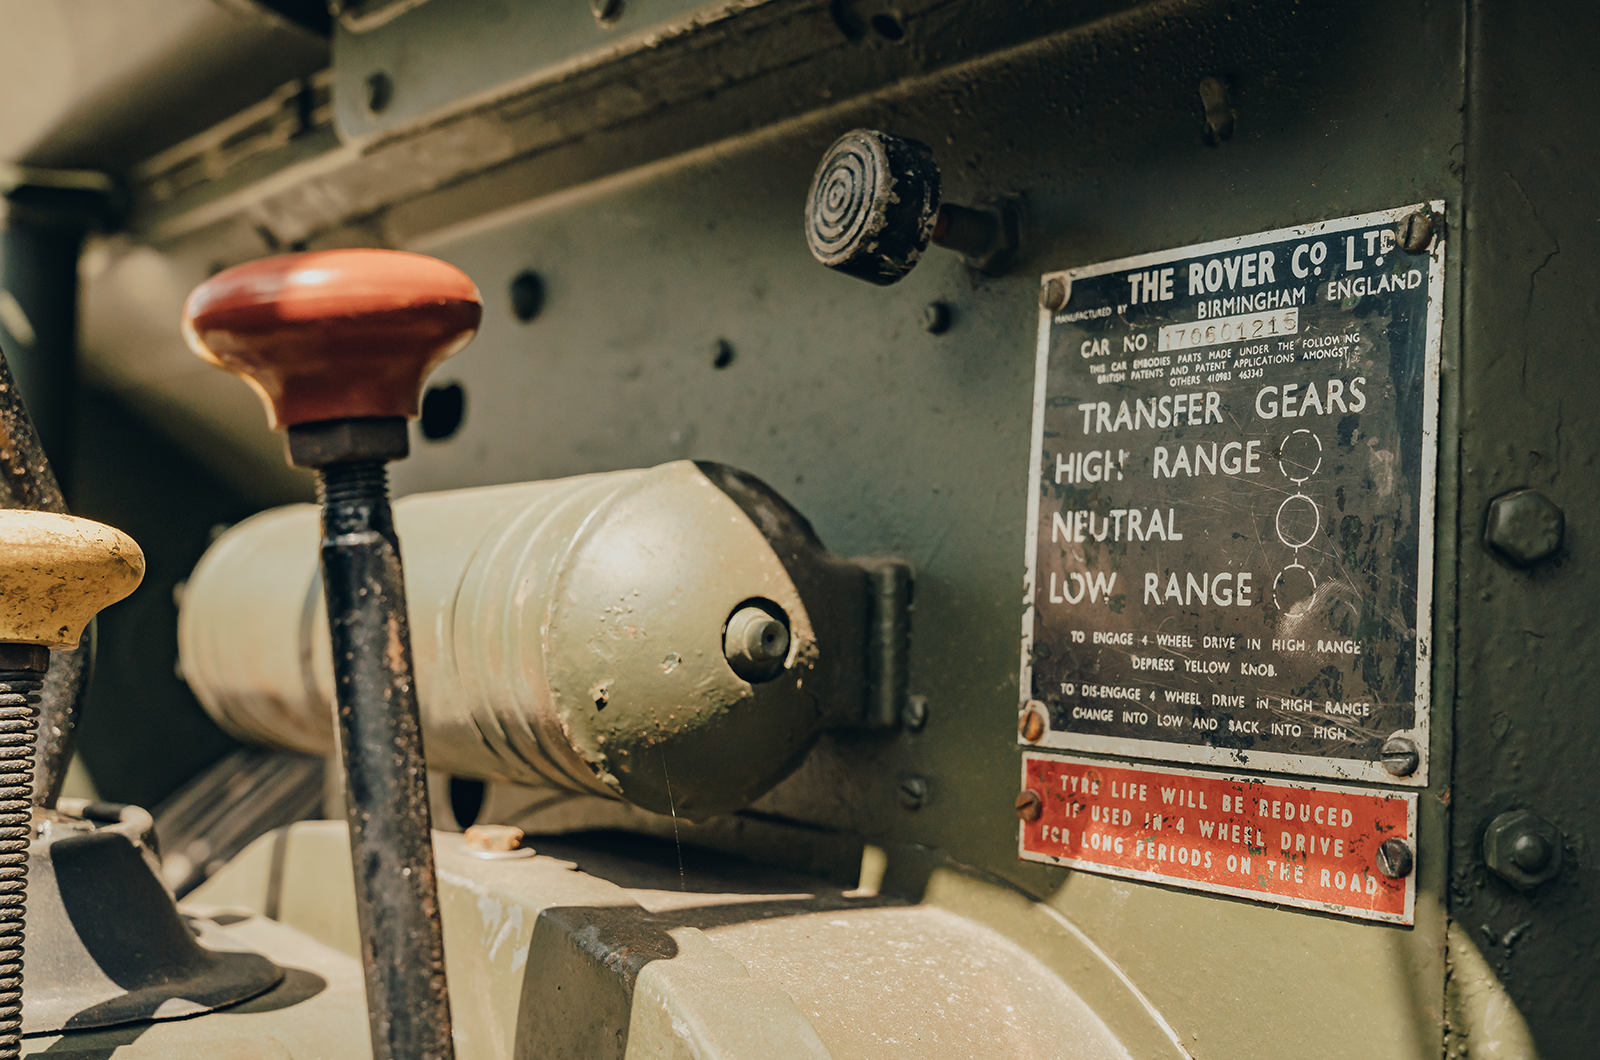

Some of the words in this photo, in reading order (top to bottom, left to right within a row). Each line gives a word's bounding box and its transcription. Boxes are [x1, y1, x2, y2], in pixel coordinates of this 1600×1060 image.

[1128, 268, 1174, 305] THE
[1189, 251, 1275, 296] ROVER
[1198, 286, 1306, 319] BIRMINGHAM
[1328, 269, 1422, 300] ENGLAND
[1117, 304, 1127, 314] BY
[1081, 338, 1110, 358] CAR
[1124, 334, 1148, 353] NO
[1090, 364, 1106, 374] THIS
[1111, 361, 1127, 371] CAR
[1133, 357, 1171, 369] EMBODIES
[1178, 353, 1201, 363] PARTS
[1209, 349, 1232, 359] MADE
[1240, 344, 1269, 356] UNDER
[1278, 341, 1294, 350] THE
[1097, 373, 1125, 384] BRITISH
[1131, 368, 1164, 379] PATENTS
[1170, 366, 1189, 376] AND
[1195, 361, 1226, 372] PATENT
[1233, 353, 1295, 368] APPLICATIONS
[1302, 346, 1349, 360] AMONGST
[1169, 375, 1201, 387] OTHERS
[1078, 391, 1223, 435] TRANSFER
[1255, 377, 1366, 419] GEARS
[1055, 449, 1124, 484] HIGH
[1153, 440, 1261, 479] RANGE
[1051, 508, 1183, 543] NEUTRAL
[1050, 571, 1117, 604] LOW
[1144, 572, 1252, 606] RANGE
[1071, 630, 1085, 643] TO
[1093, 631, 1134, 645] ENGAGE
[1141, 635, 1148, 645] 4
[1157, 634, 1193, 648] WHEEL
[1203, 636, 1236, 650] DRIVE
[1247, 638, 1261, 650] IN
[1272, 639, 1305, 651] HIGH
[1317, 640, 1361, 654] RANGE
[1132, 657, 1174, 671] DEPRESS
[1184, 660, 1231, 674] YELLOW
[1240, 662, 1278, 677] KNOB.
[1060, 682, 1075, 696] TO
[1149, 691, 1156, 701] 4
[1164, 690, 1202, 705] WHEEL
[1212, 694, 1245, 709] DRIVE
[1256, 697, 1269, 709] IN
[1280, 698, 1313, 712] HIGH
[1325, 701, 1370, 717] RANGE
[1072, 706, 1114, 722] CHANGE
[1122, 711, 1149, 725] INTO
[1157, 714, 1184, 727] LOW
[1192, 717, 1218, 731] AND
[1228, 719, 1260, 734] BACK
[1271, 723, 1302, 737] INTO
[1313, 726, 1347, 741] HIGH
[1060, 775, 1099, 795] TYRE
[1112, 781, 1147, 801] LIFE
[1161, 786, 1208, 809] WILL
[1222, 794, 1244, 814] BE
[1259, 798, 1353, 828] REDUCED
[1065, 802, 1080, 818] IF
[1091, 805, 1132, 826] USED
[1144, 812, 1162, 831] IN
[1175, 817, 1185, 834] 4
[1199, 819, 1265, 847] WHEEL
[1281, 831, 1344, 858] DRIVE
[1042, 824, 1070, 845] FOR
[1081, 831, 1124, 854] LONG
[1136, 839, 1212, 869] PERIODS
[1226, 854, 1251, 875] ON
[1267, 860, 1304, 884] THE
[1320, 868, 1378, 895] ROAD
